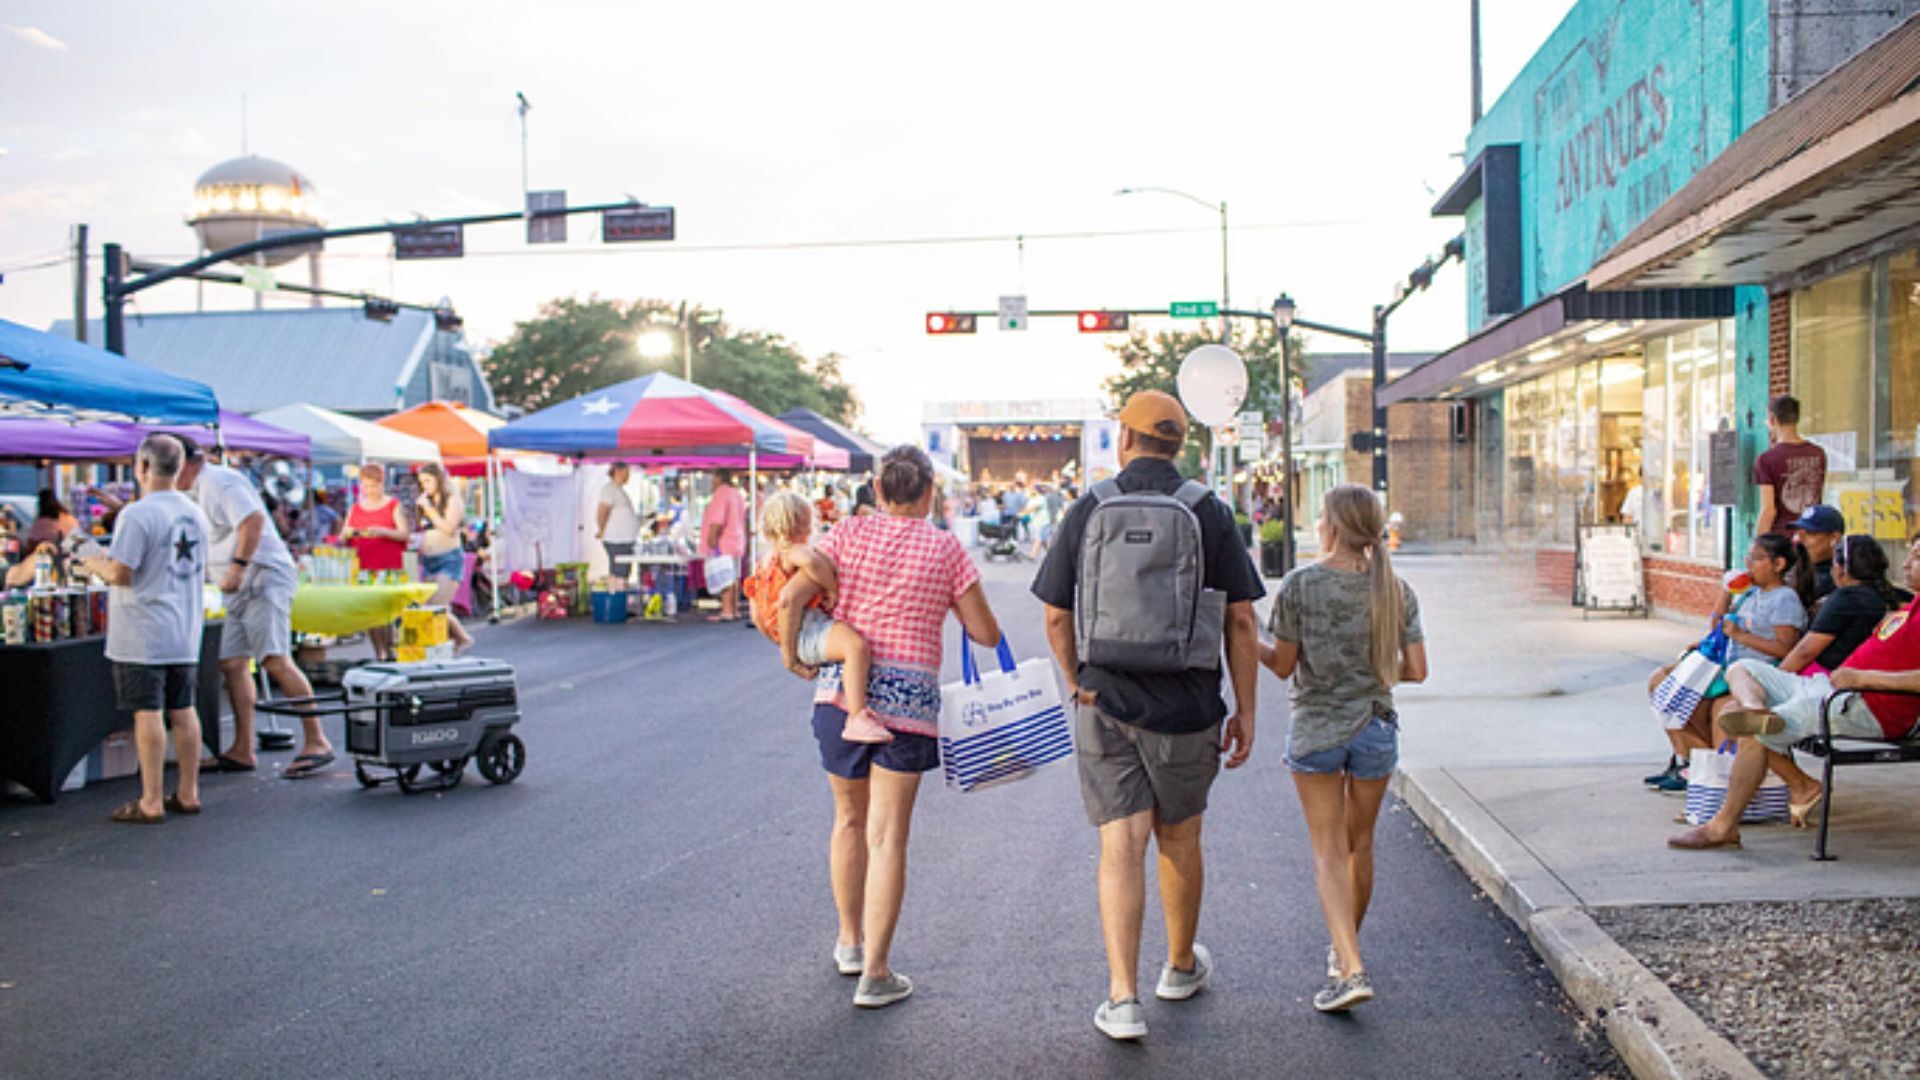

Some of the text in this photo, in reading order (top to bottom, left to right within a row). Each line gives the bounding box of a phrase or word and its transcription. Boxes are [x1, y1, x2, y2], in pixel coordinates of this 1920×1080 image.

[1554, 62, 1669, 215] ANTIQUES
[1175, 304, 1197, 315] 2nd
[411, 728, 459, 745] IGLOO
